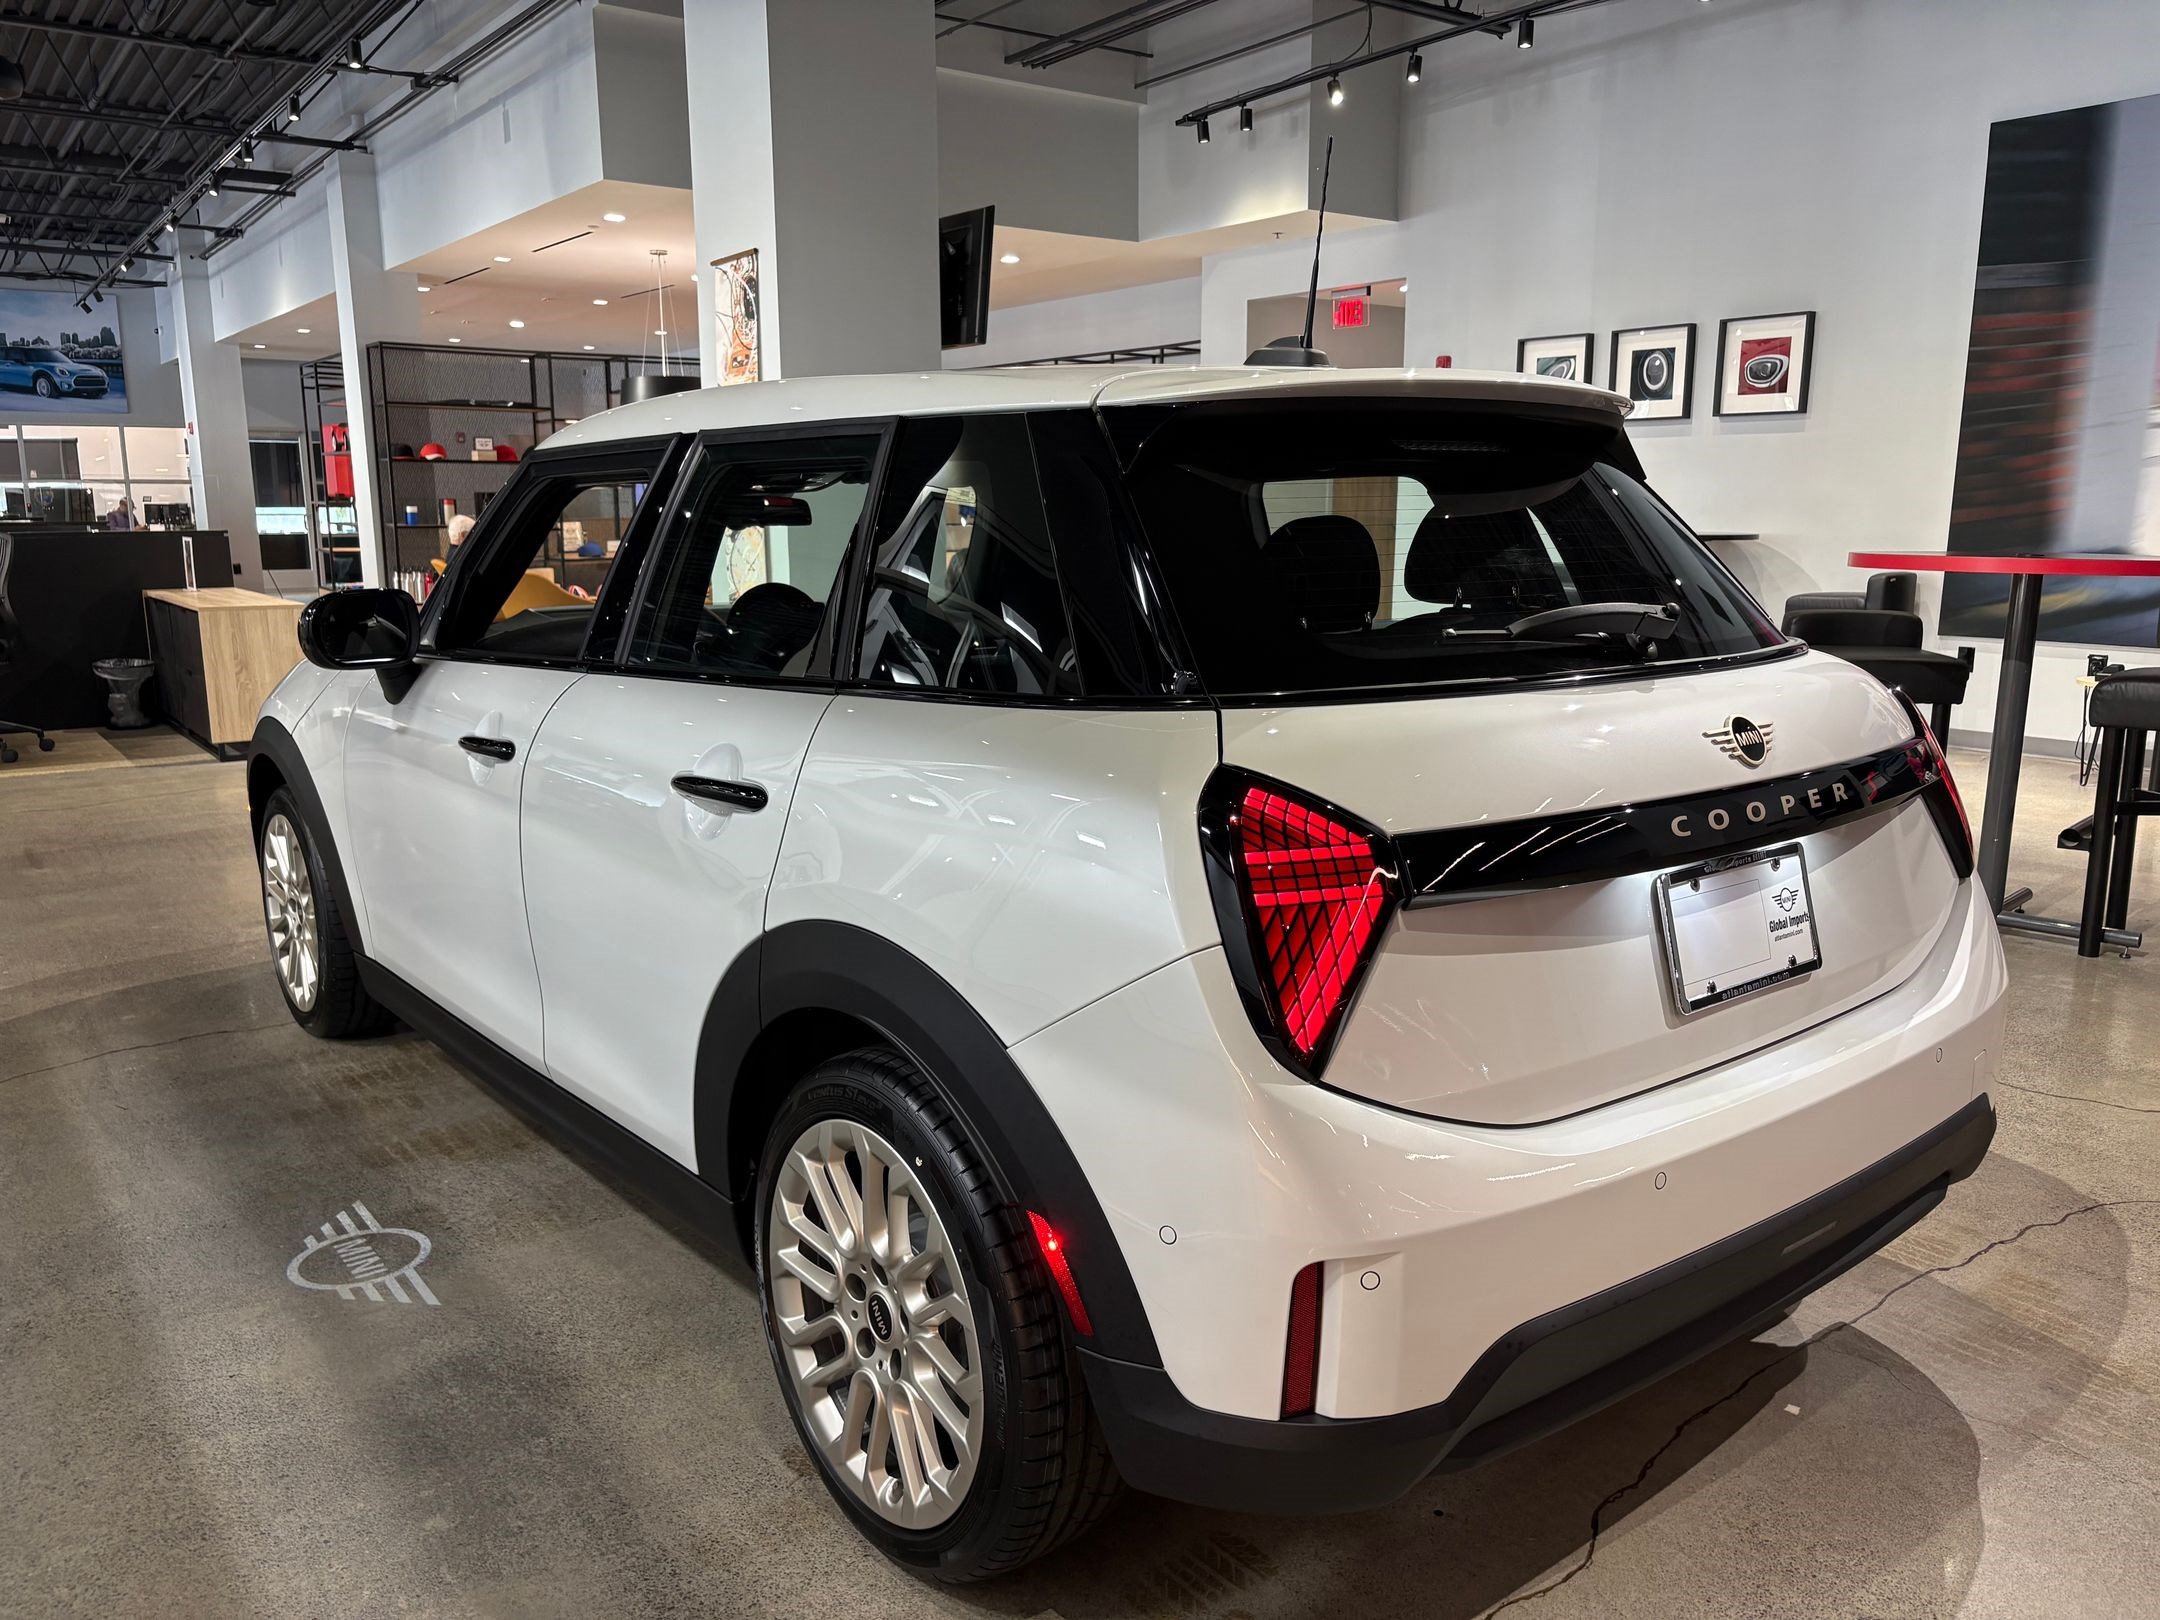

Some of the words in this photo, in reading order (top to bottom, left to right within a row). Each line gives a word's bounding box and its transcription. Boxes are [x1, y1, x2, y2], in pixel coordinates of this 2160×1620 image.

[1735, 730, 1763, 747] MINI
[1671, 782, 1849, 837] COOPER
[1769, 916, 1789, 933] Global
[1789, 911, 1810, 927] Imports
[1721, 972, 1791, 1000] atlantamini.com
[333, 1238, 389, 1279] MINI
[871, 1300, 888, 1336] MINI
